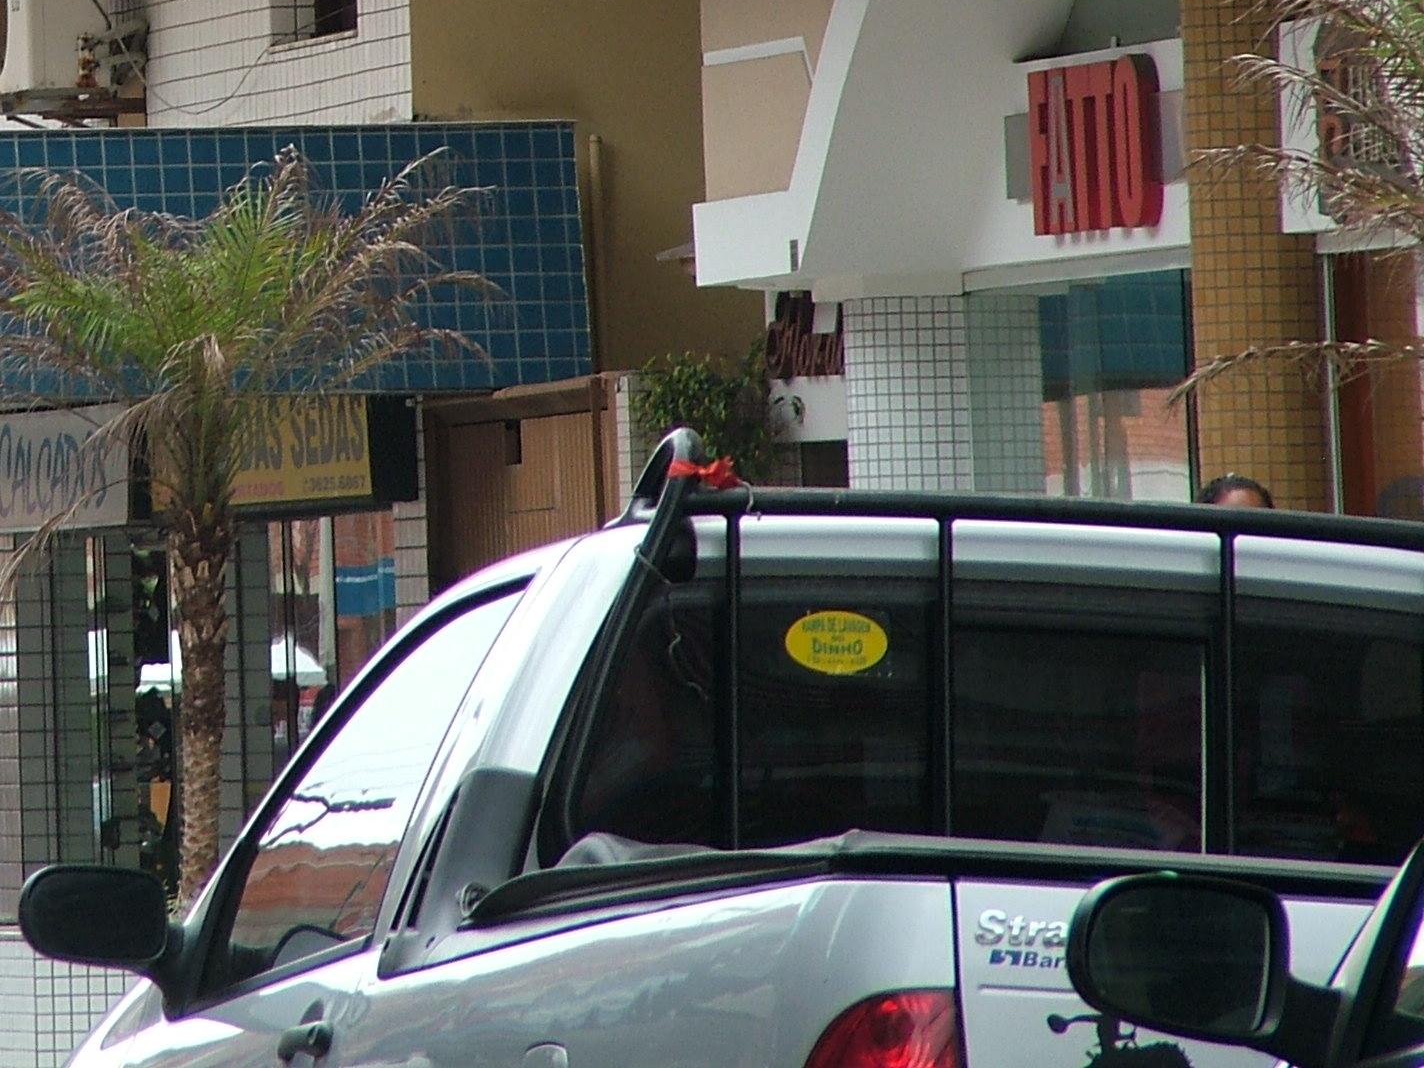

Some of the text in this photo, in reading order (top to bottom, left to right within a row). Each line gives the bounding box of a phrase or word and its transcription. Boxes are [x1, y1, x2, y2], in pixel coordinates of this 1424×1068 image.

[1028, 54, 1156, 236] FATTO
[812, 637, 863, 655] DINHO
[975, 908, 1069, 947] Stra
